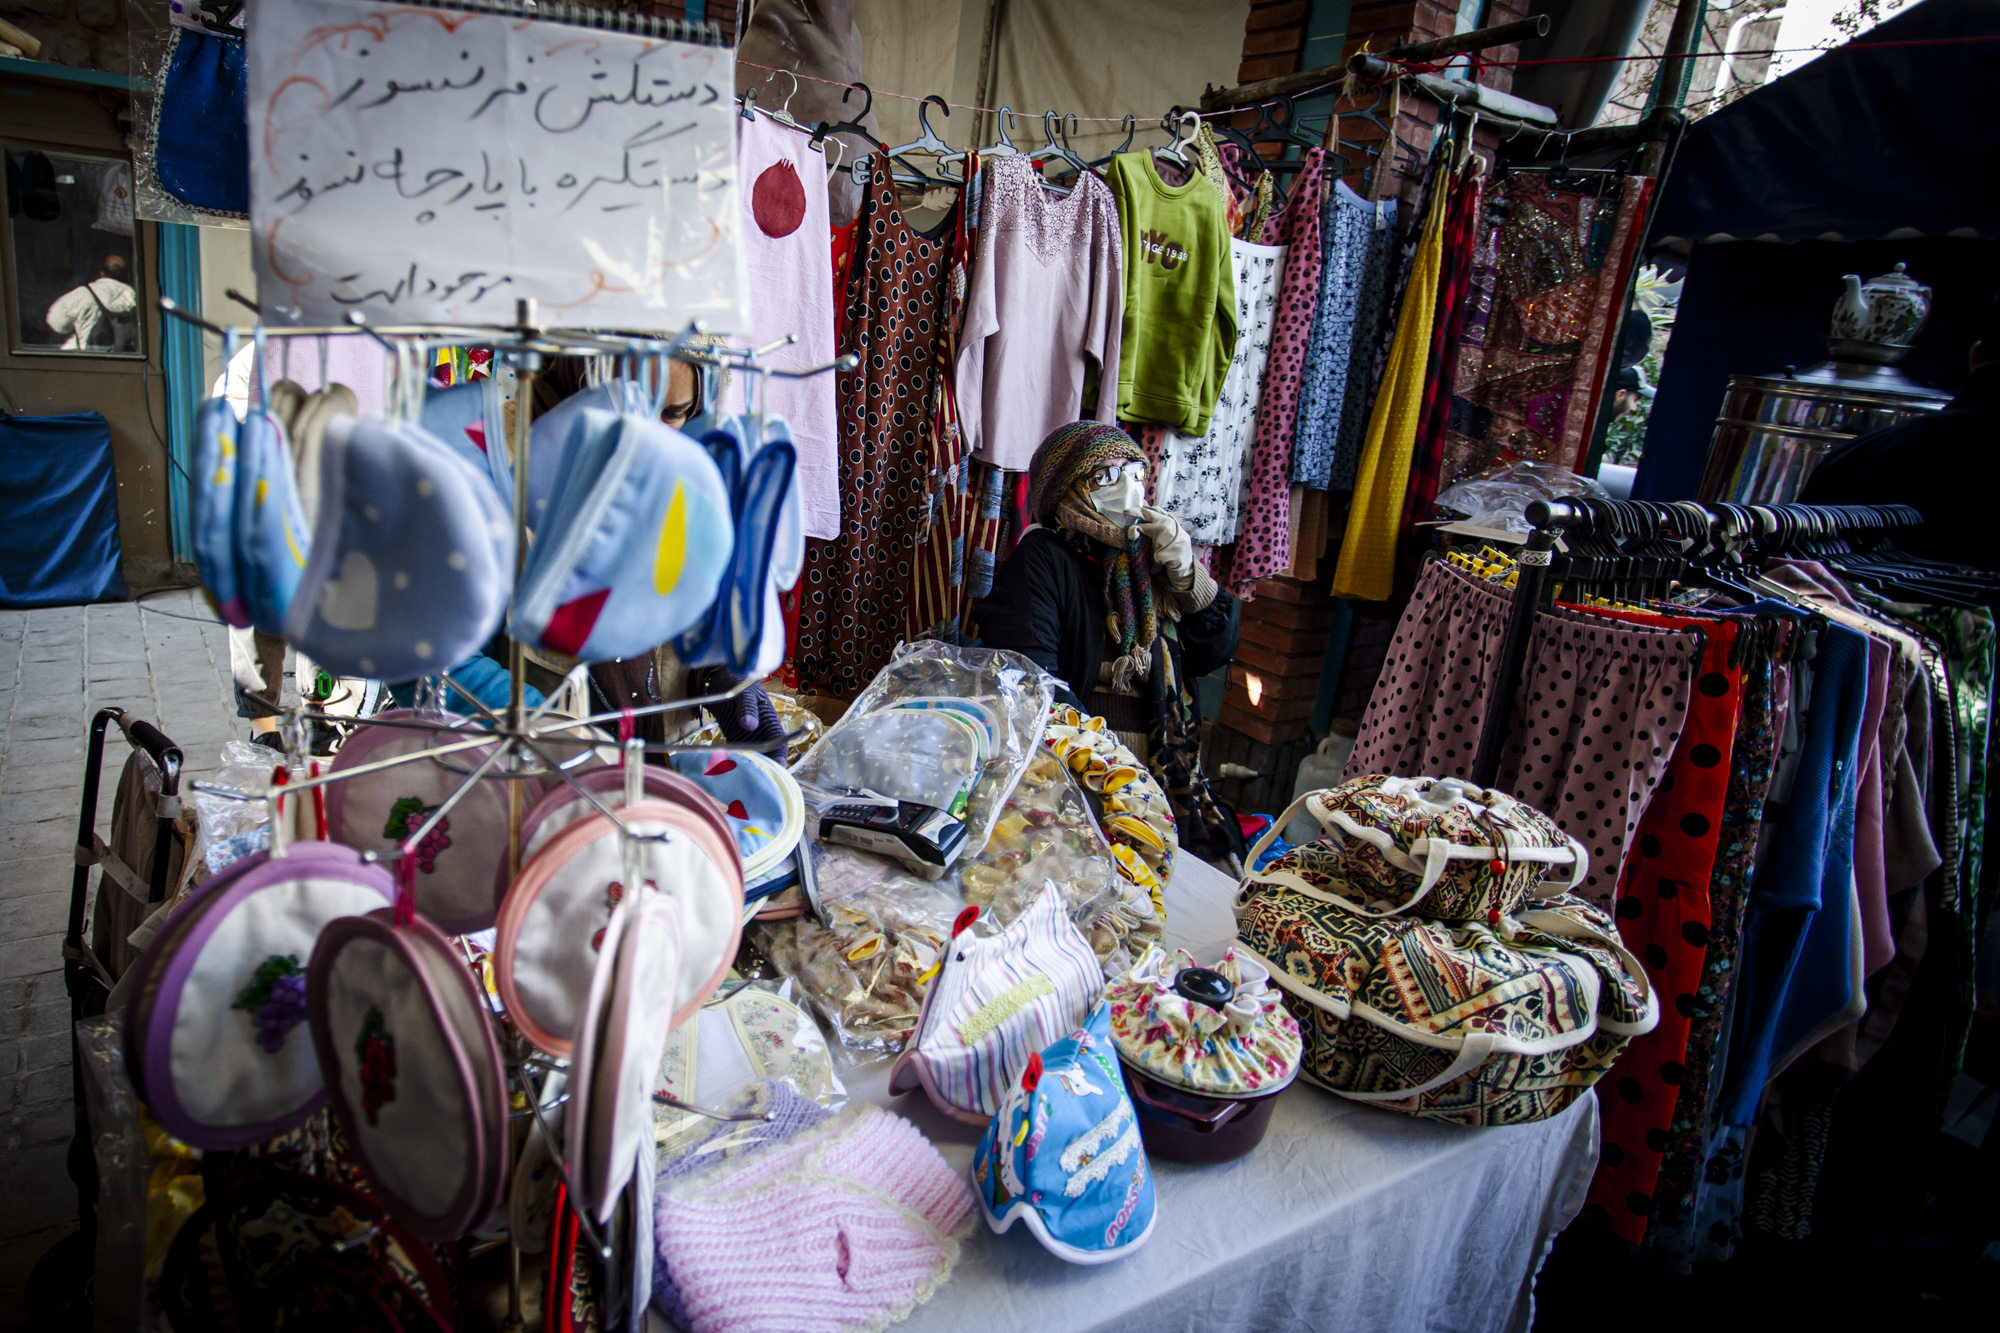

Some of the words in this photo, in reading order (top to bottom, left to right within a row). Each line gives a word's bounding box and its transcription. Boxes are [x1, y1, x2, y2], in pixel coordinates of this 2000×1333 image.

[322, 48, 485, 116] نسوز
[535, 42, 719, 134] دستکش
[274, 150, 365, 216] نسوز
[374, 147, 506, 225] پارچه
[517, 157, 538, 208] با
[556, 120, 727, 214] دستگیره
[330, 252, 418, 304] است
[1140, 239, 1164, 255] TAGE
[1165, 247, 1189, 261] 1938
[422, 265, 514, 315] موجود
[1105, 1184, 1139, 1247] SHOW
